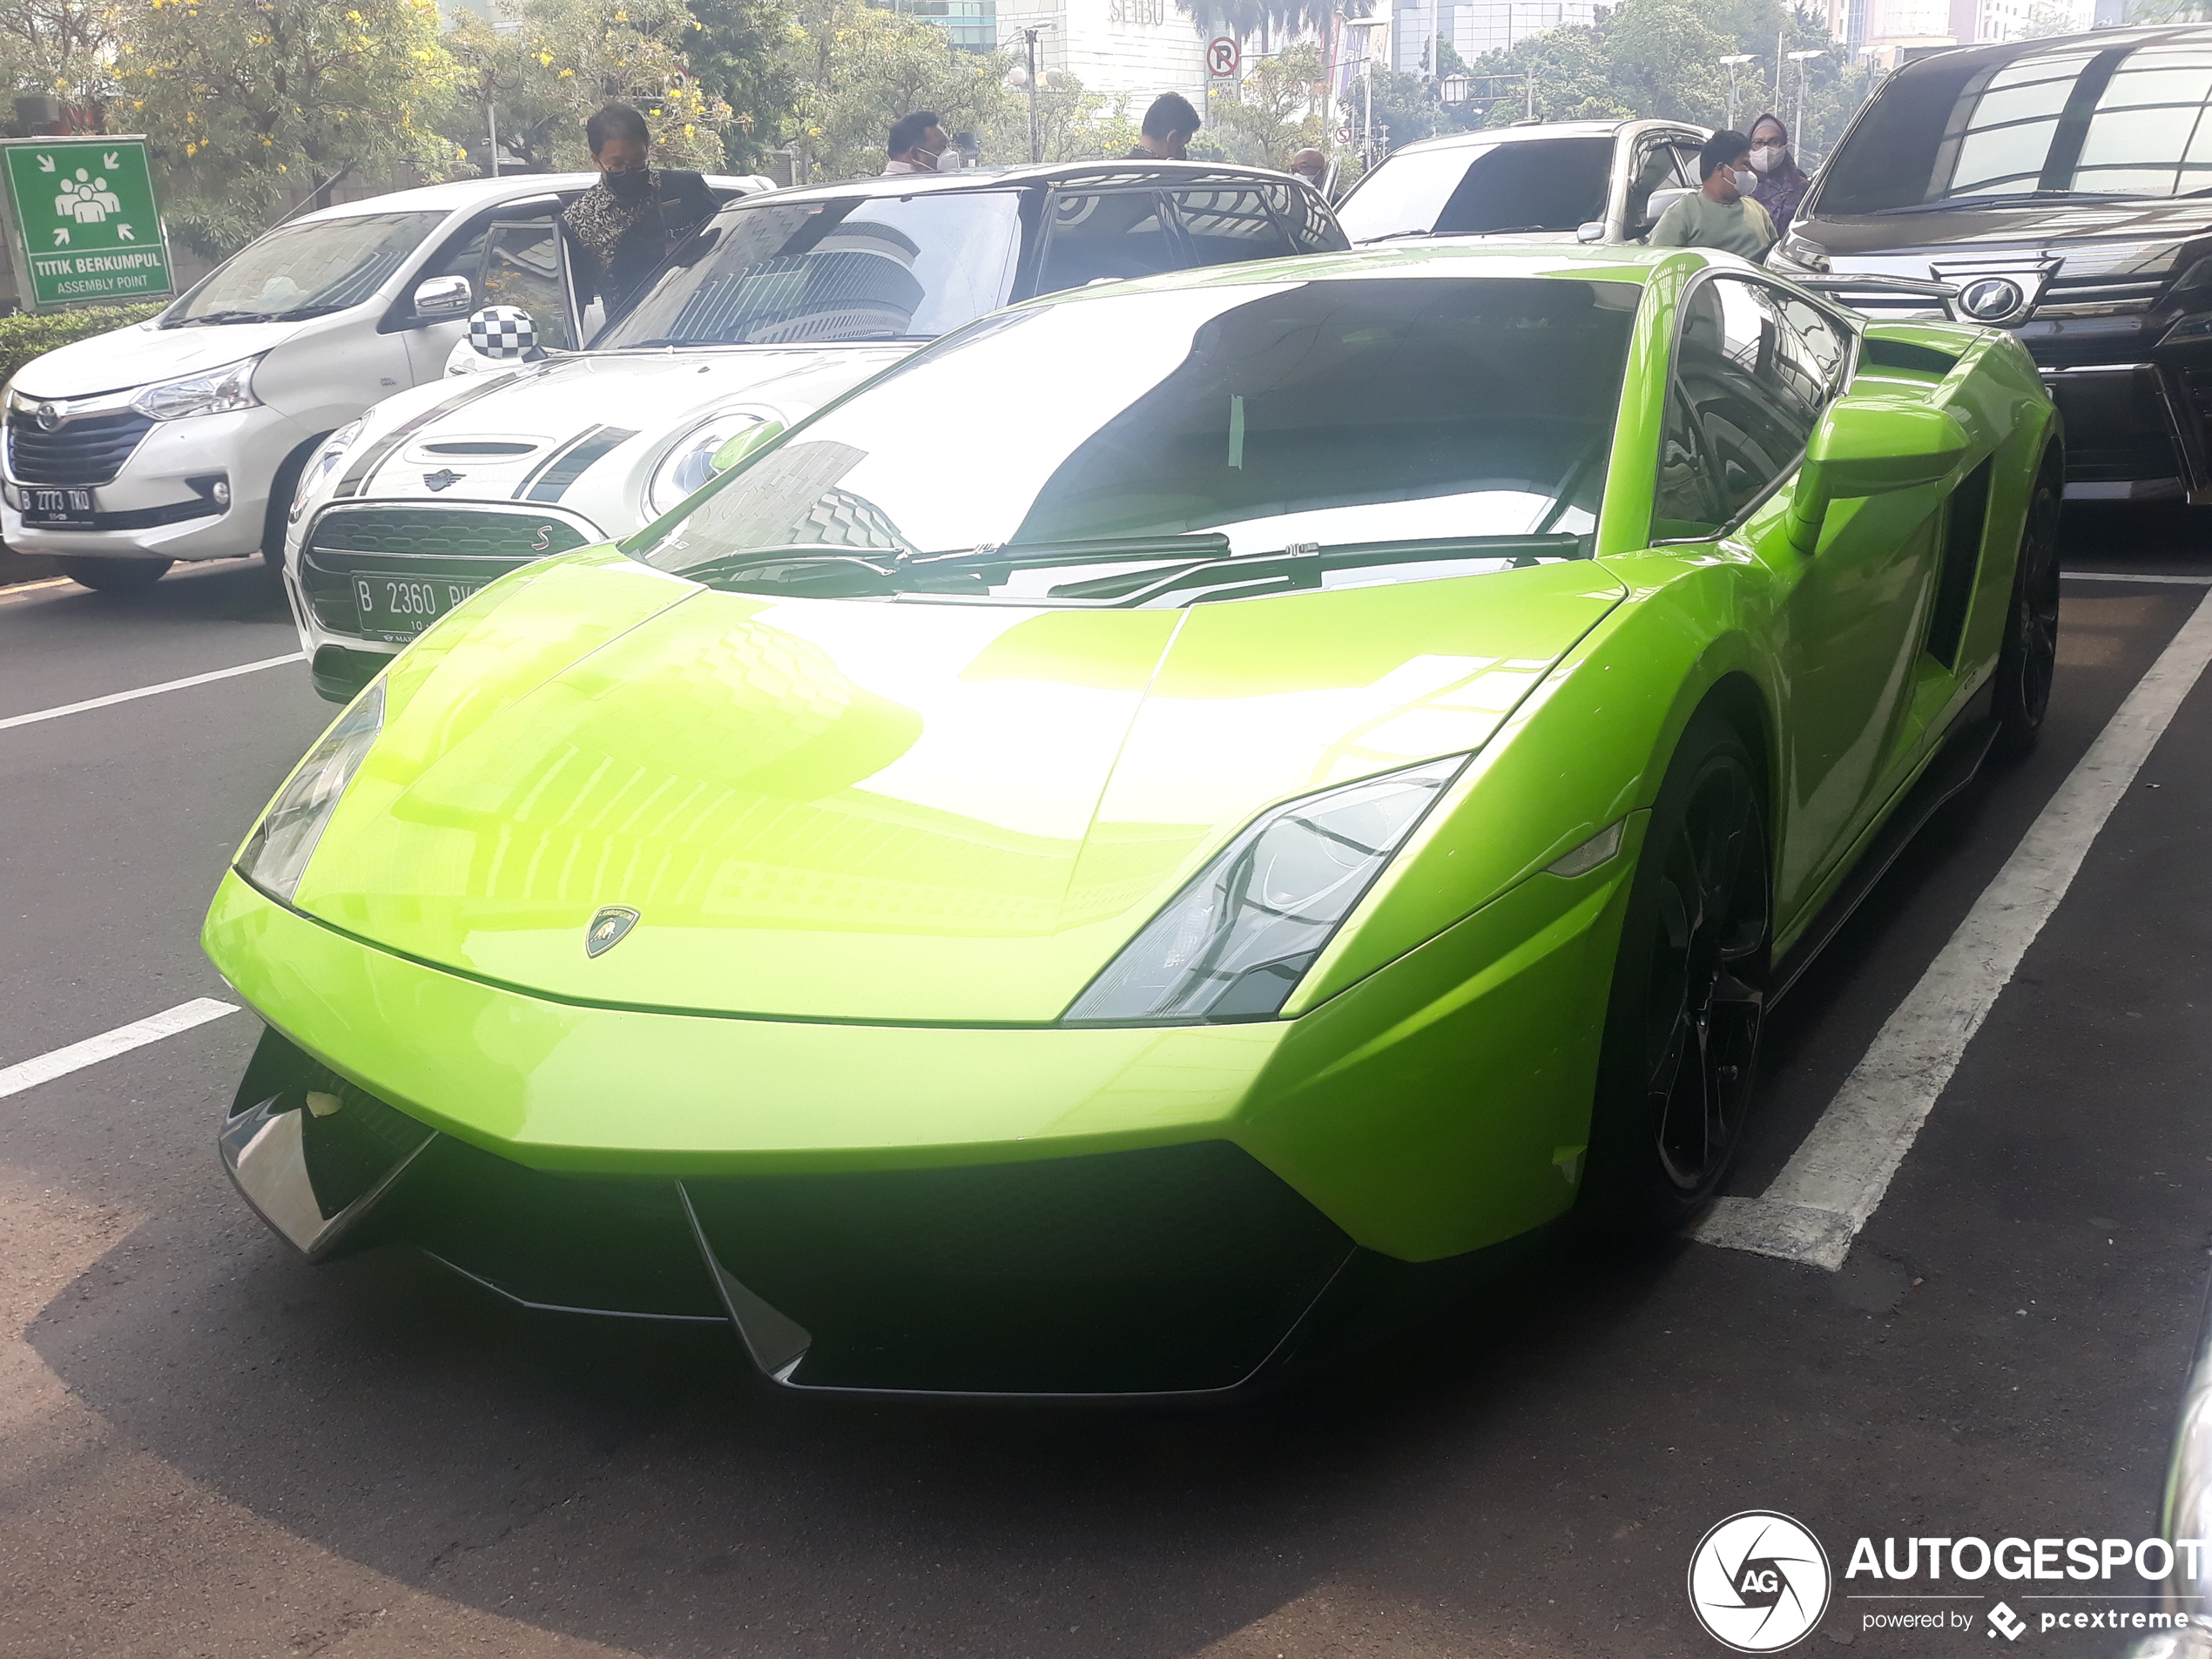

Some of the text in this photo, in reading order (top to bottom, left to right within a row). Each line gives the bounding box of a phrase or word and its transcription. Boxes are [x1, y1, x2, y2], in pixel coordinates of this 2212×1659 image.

[36, 253, 162, 277] TITIK BERKUMPUL
[57, 274, 148, 294] ASSEMBLY POINT
[21, 490, 31, 510] B
[36, 490, 64, 510] 2773
[531, 525, 553, 551] S
[358, 581, 374, 611] B
[387, 582, 436, 615] 2360
